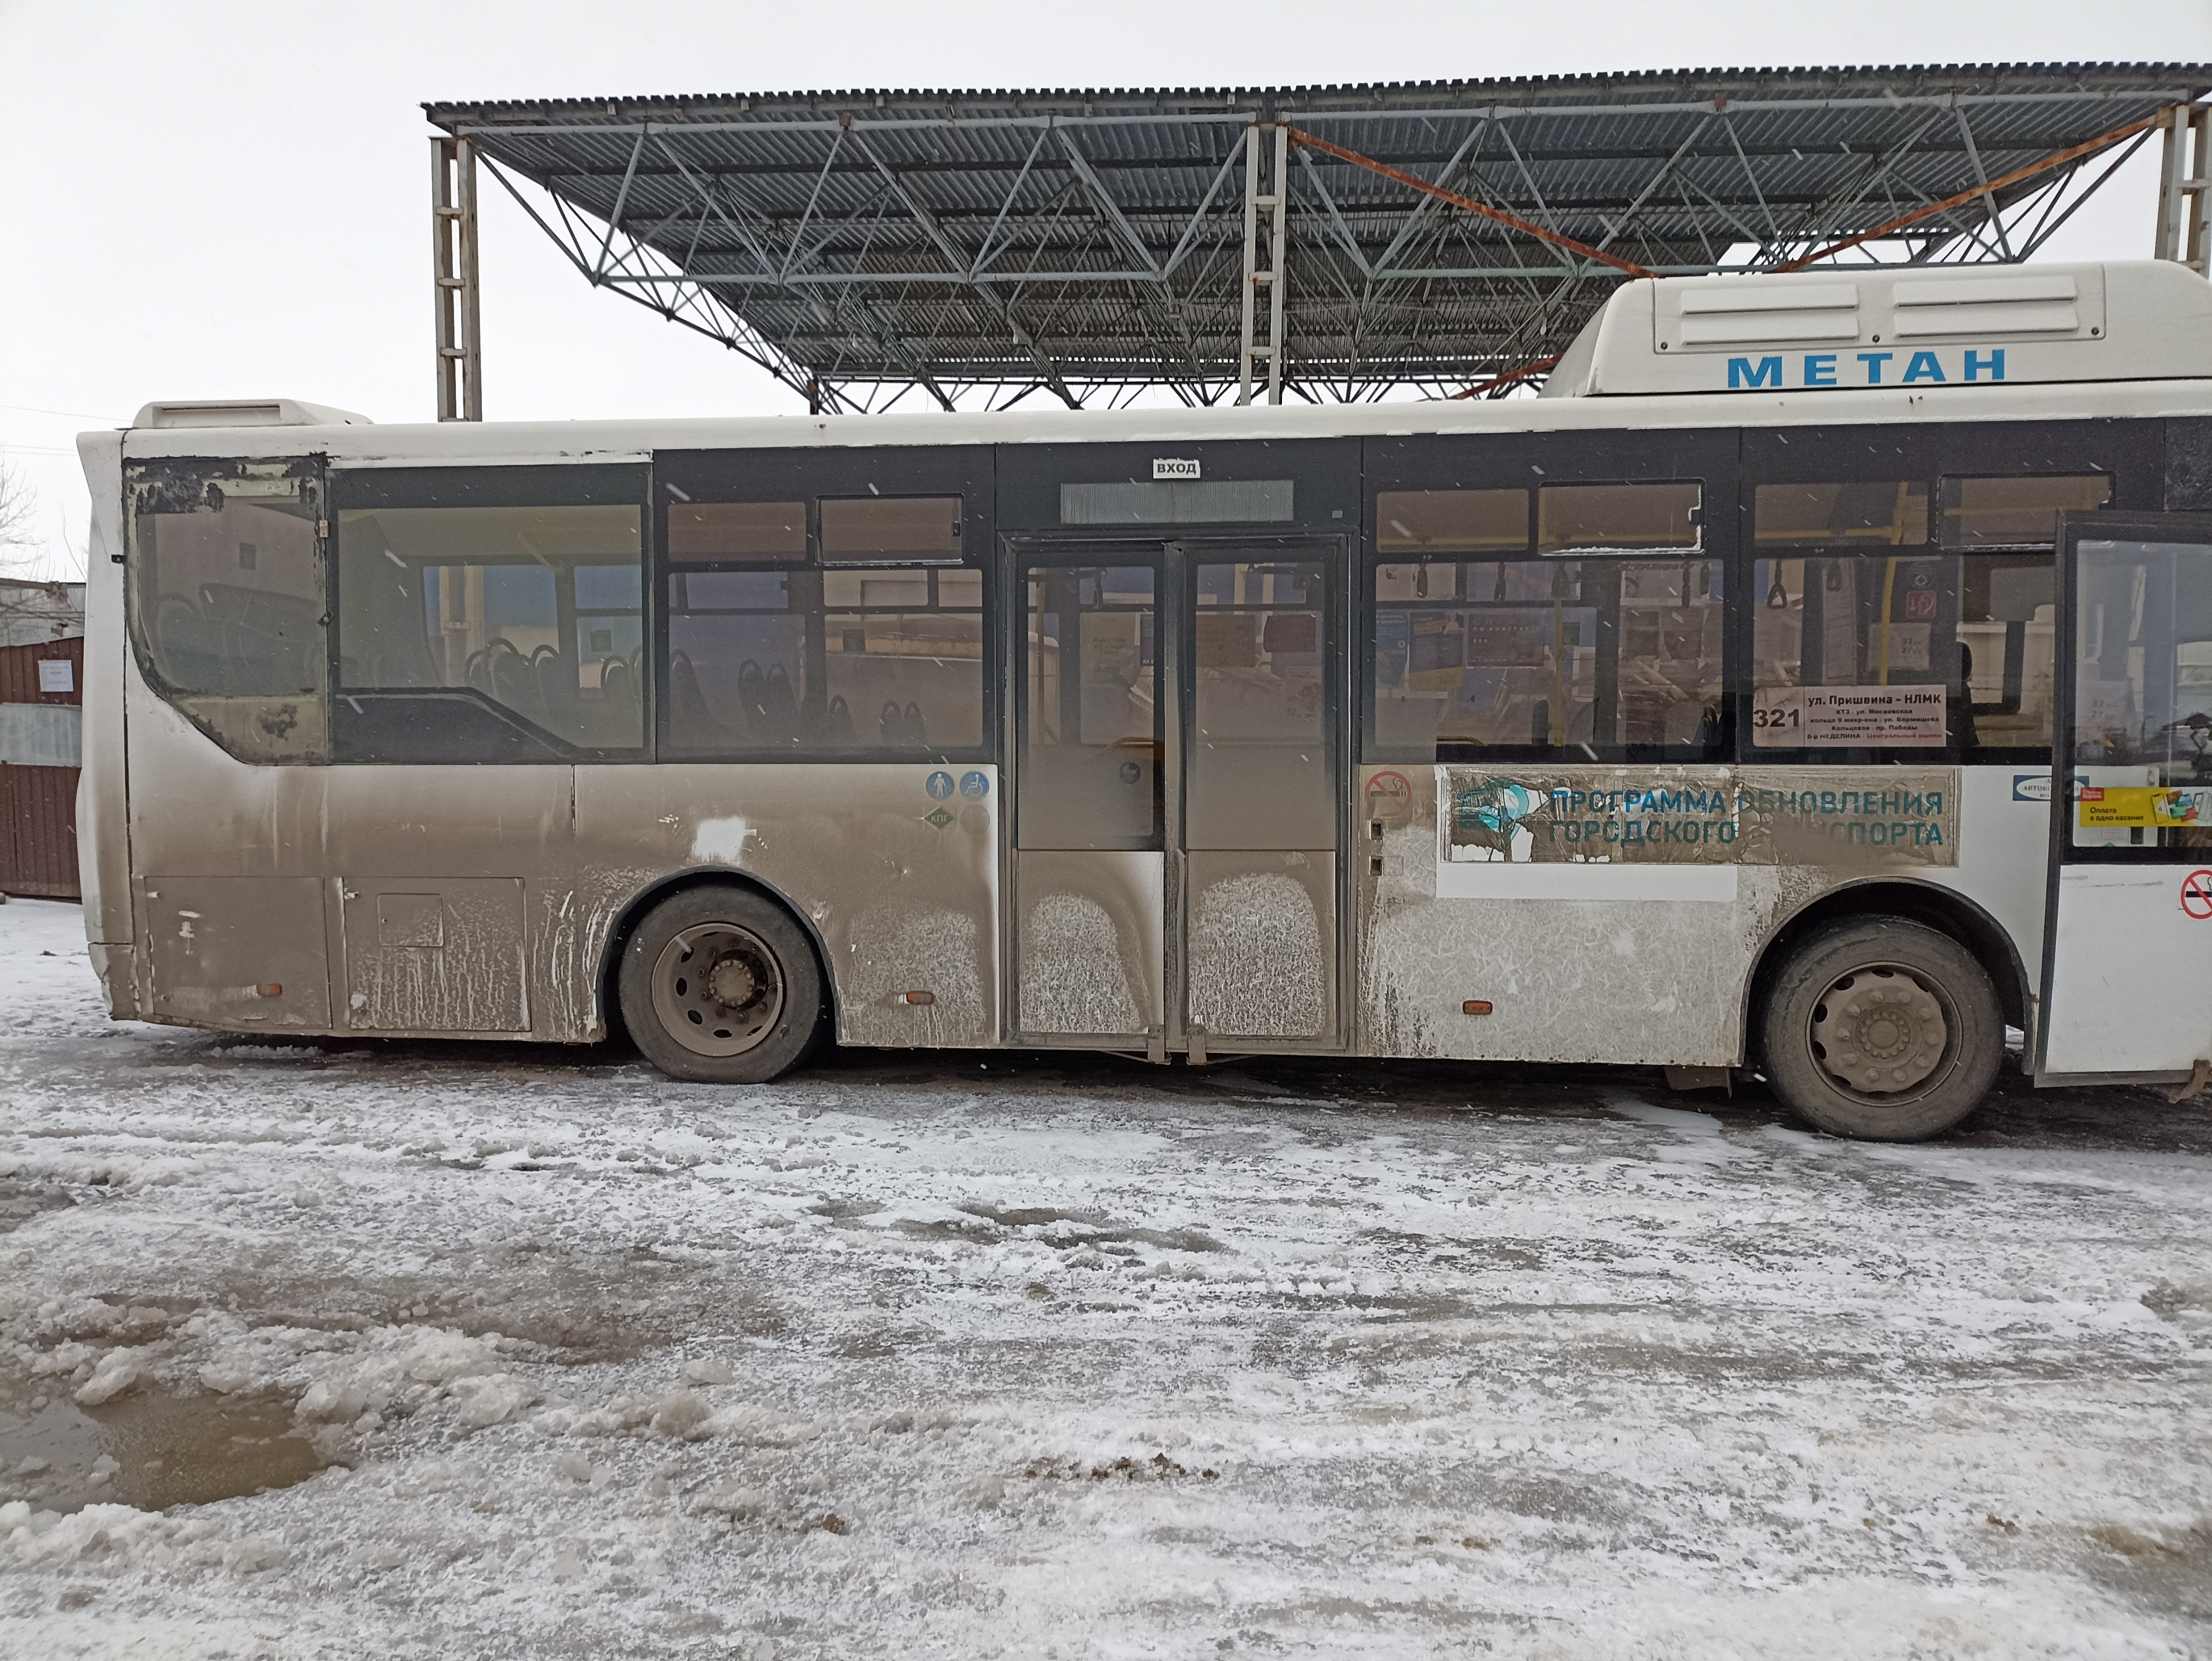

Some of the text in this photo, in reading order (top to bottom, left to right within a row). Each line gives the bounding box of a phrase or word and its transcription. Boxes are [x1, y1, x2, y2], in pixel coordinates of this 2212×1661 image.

[1728, 349, 2005, 388] МЕТАН
[1157, 463, 1196, 475] ВХОД
[1808, 697, 1826, 707] ул.
[1829, 695, 1893, 706] Пришвина
[1905, 694, 1941, 704] НЛМК
[1753, 708, 1800, 728] 321
[1549, 789, 1726, 813] ПРОГРАММА
[930, 814, 949, 822] КПГ
[1549, 820, 1736, 848] ГОРОДСКОГО
